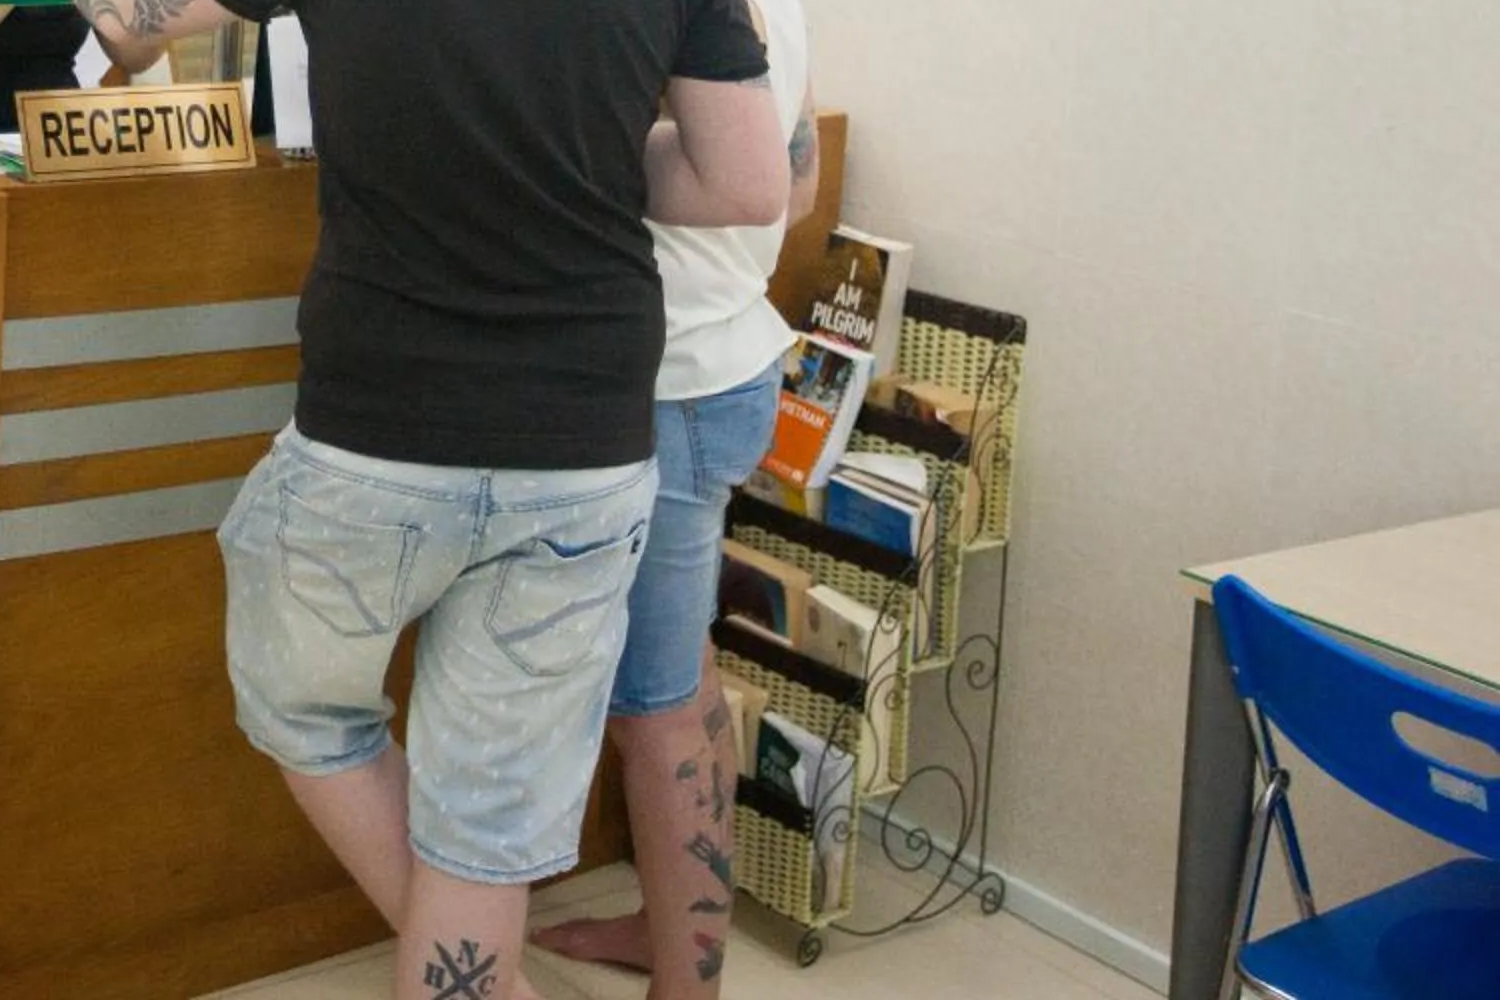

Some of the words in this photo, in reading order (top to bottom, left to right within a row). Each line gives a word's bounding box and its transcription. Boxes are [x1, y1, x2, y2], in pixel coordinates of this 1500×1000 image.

[40, 103, 234, 158] RECEPTION
[849, 258, 858, 281] I
[833, 282, 862, 311] AM
[811, 301, 875, 344] PILGRIM
